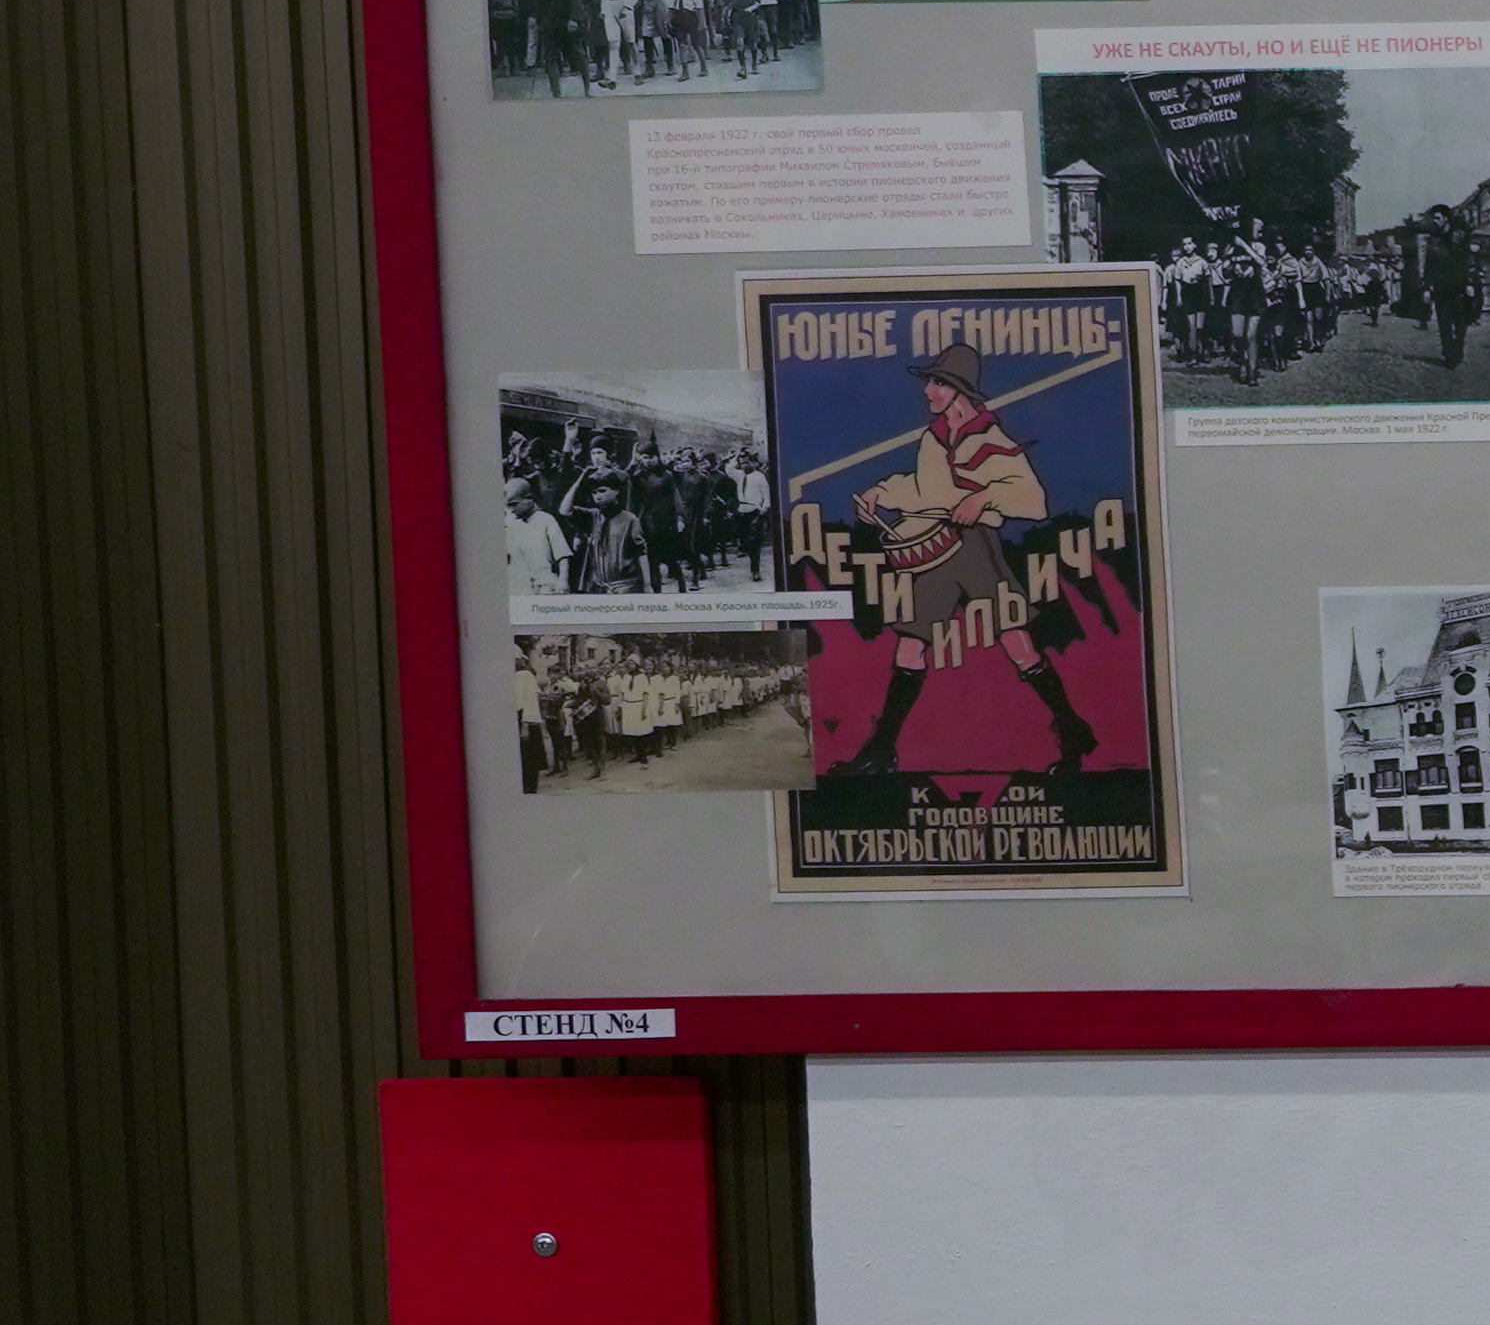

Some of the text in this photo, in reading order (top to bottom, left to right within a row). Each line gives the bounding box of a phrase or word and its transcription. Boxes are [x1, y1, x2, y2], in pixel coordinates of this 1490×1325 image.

[1092, 34, 1482, 58] УЖЕ НЕ СКАУТЫ, НО И ЕЩЁ НЕ ПИОНЕРЫ
[777, 310, 897, 361] ЮНЫЕ
[790, 503, 914, 622] ДЕТИ
[933, 498, 1125, 669] ИЛЬИЧА
[909, 806, 1065, 827] ГОДОВЩИНЕ
[993, 825, 1152, 862] РЕВОЛЮЦИИ
[492, 1012, 650, 1039] СТЕНД №4
